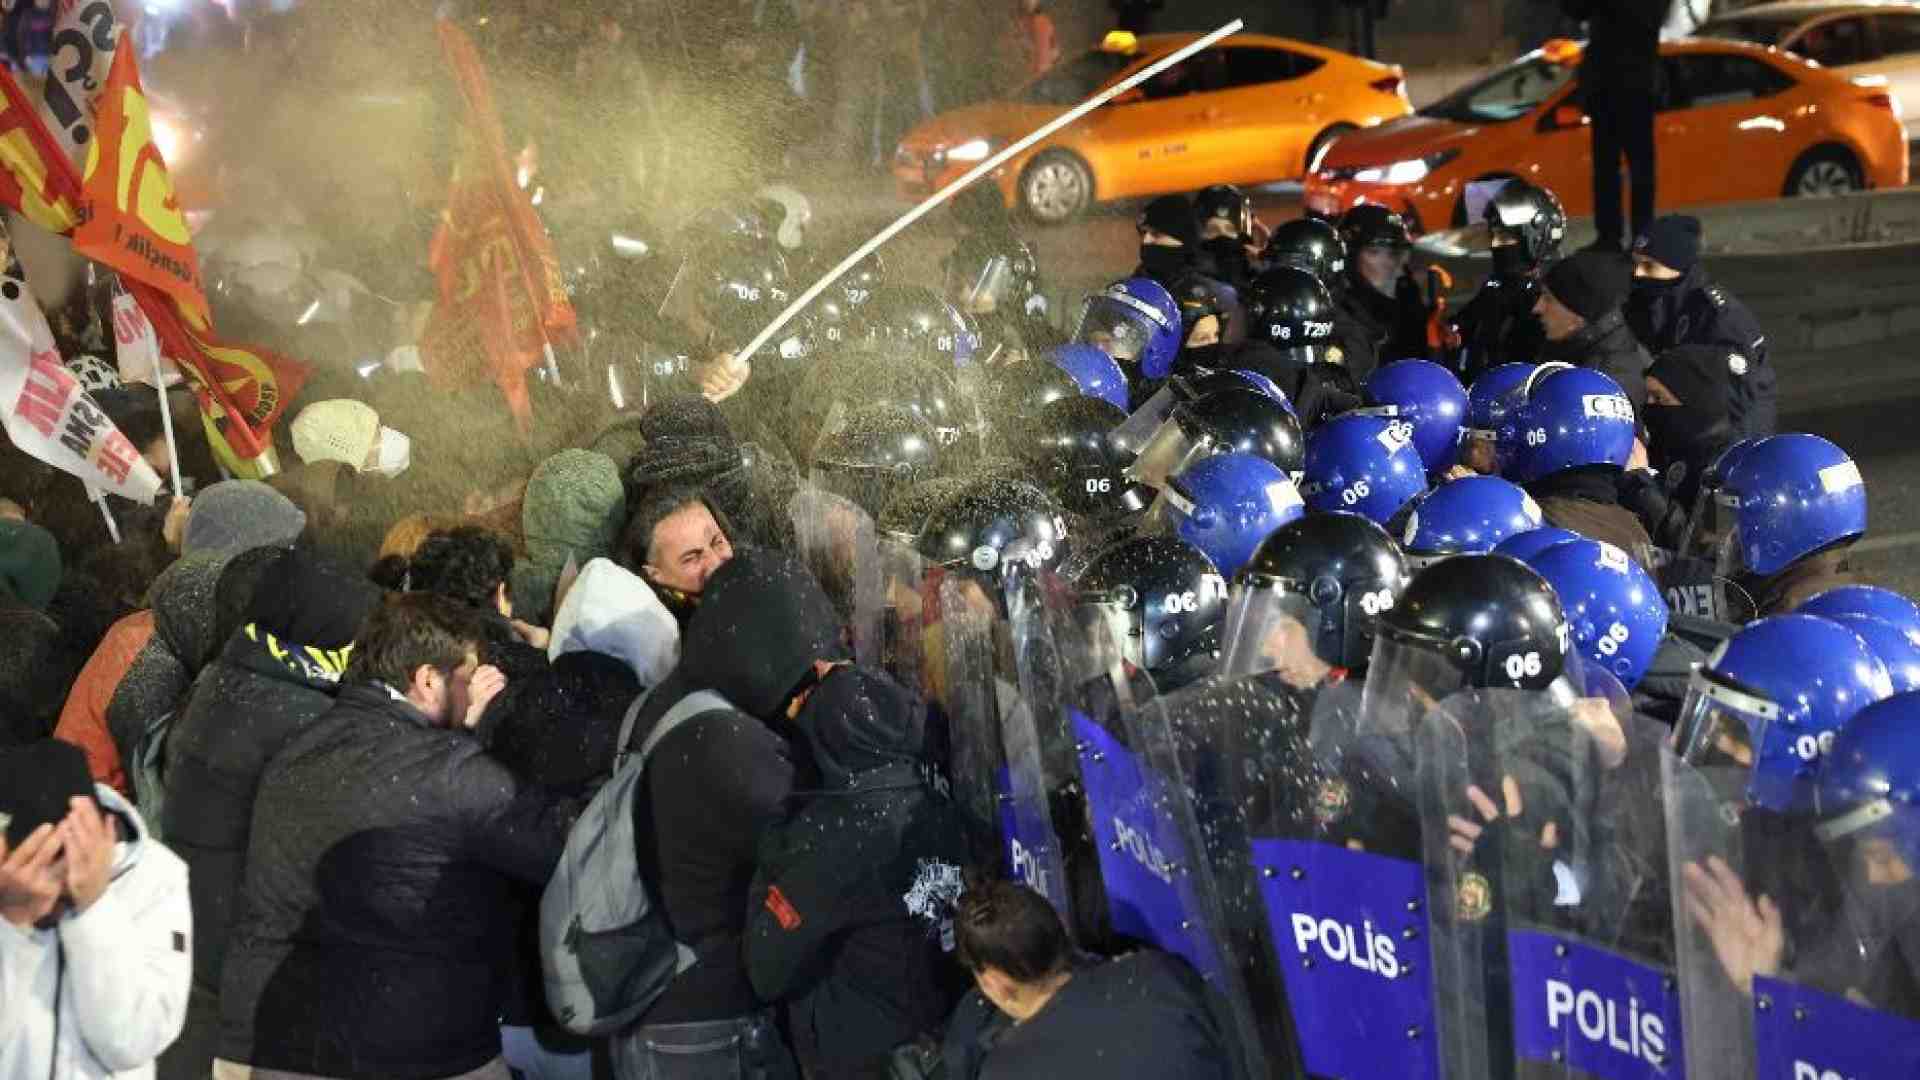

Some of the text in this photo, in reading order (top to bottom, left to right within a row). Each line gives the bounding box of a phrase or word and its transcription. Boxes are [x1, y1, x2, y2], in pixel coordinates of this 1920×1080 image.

[1527, 426, 1547, 447] 06
[1085, 477, 1112, 494] 06
[1342, 480, 1370, 505] 06
[1361, 587, 1395, 616] 06
[1598, 621, 1630, 657] 06
[1505, 651, 1542, 681] 06
[1291, 912, 1398, 979] POLİS
[1545, 978, 1666, 1069] POLİS
